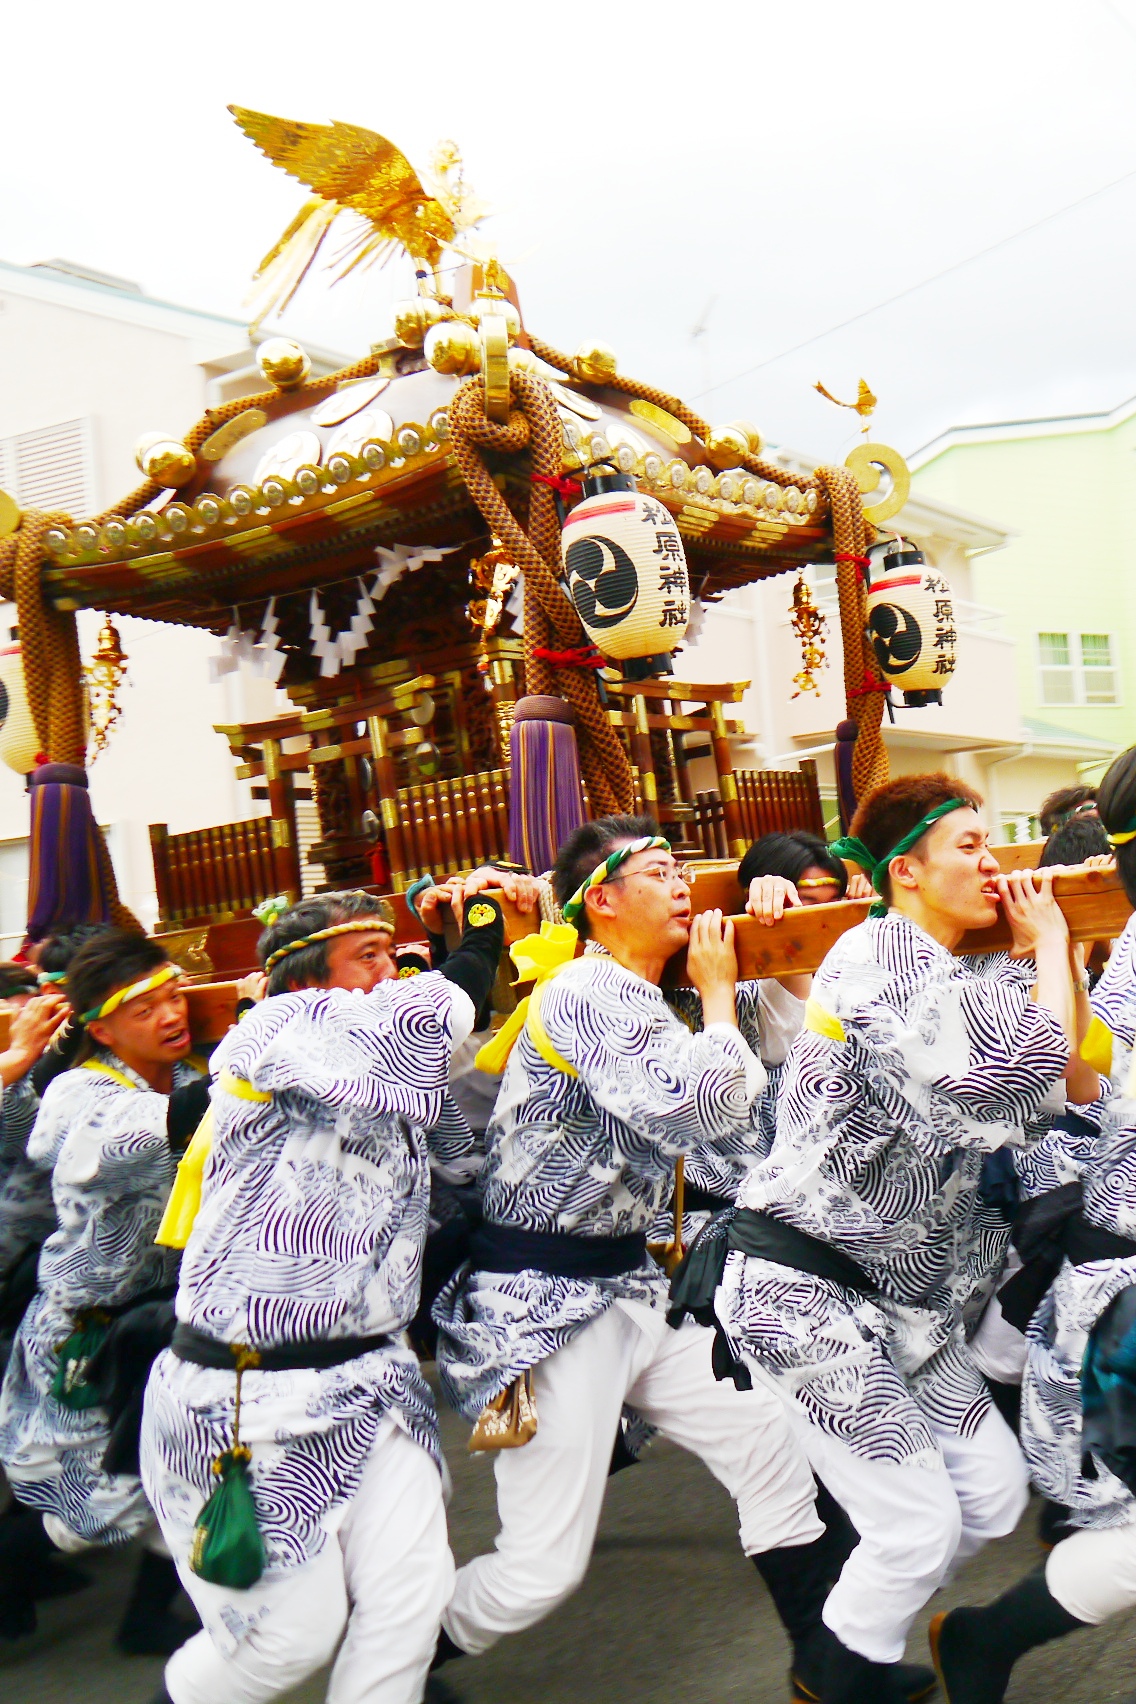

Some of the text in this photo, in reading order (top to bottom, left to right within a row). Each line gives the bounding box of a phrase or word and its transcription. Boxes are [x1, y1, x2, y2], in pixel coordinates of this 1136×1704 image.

[641, 502, 687, 627] 松原神社
[922, 575, 957, 675] 松原神社
